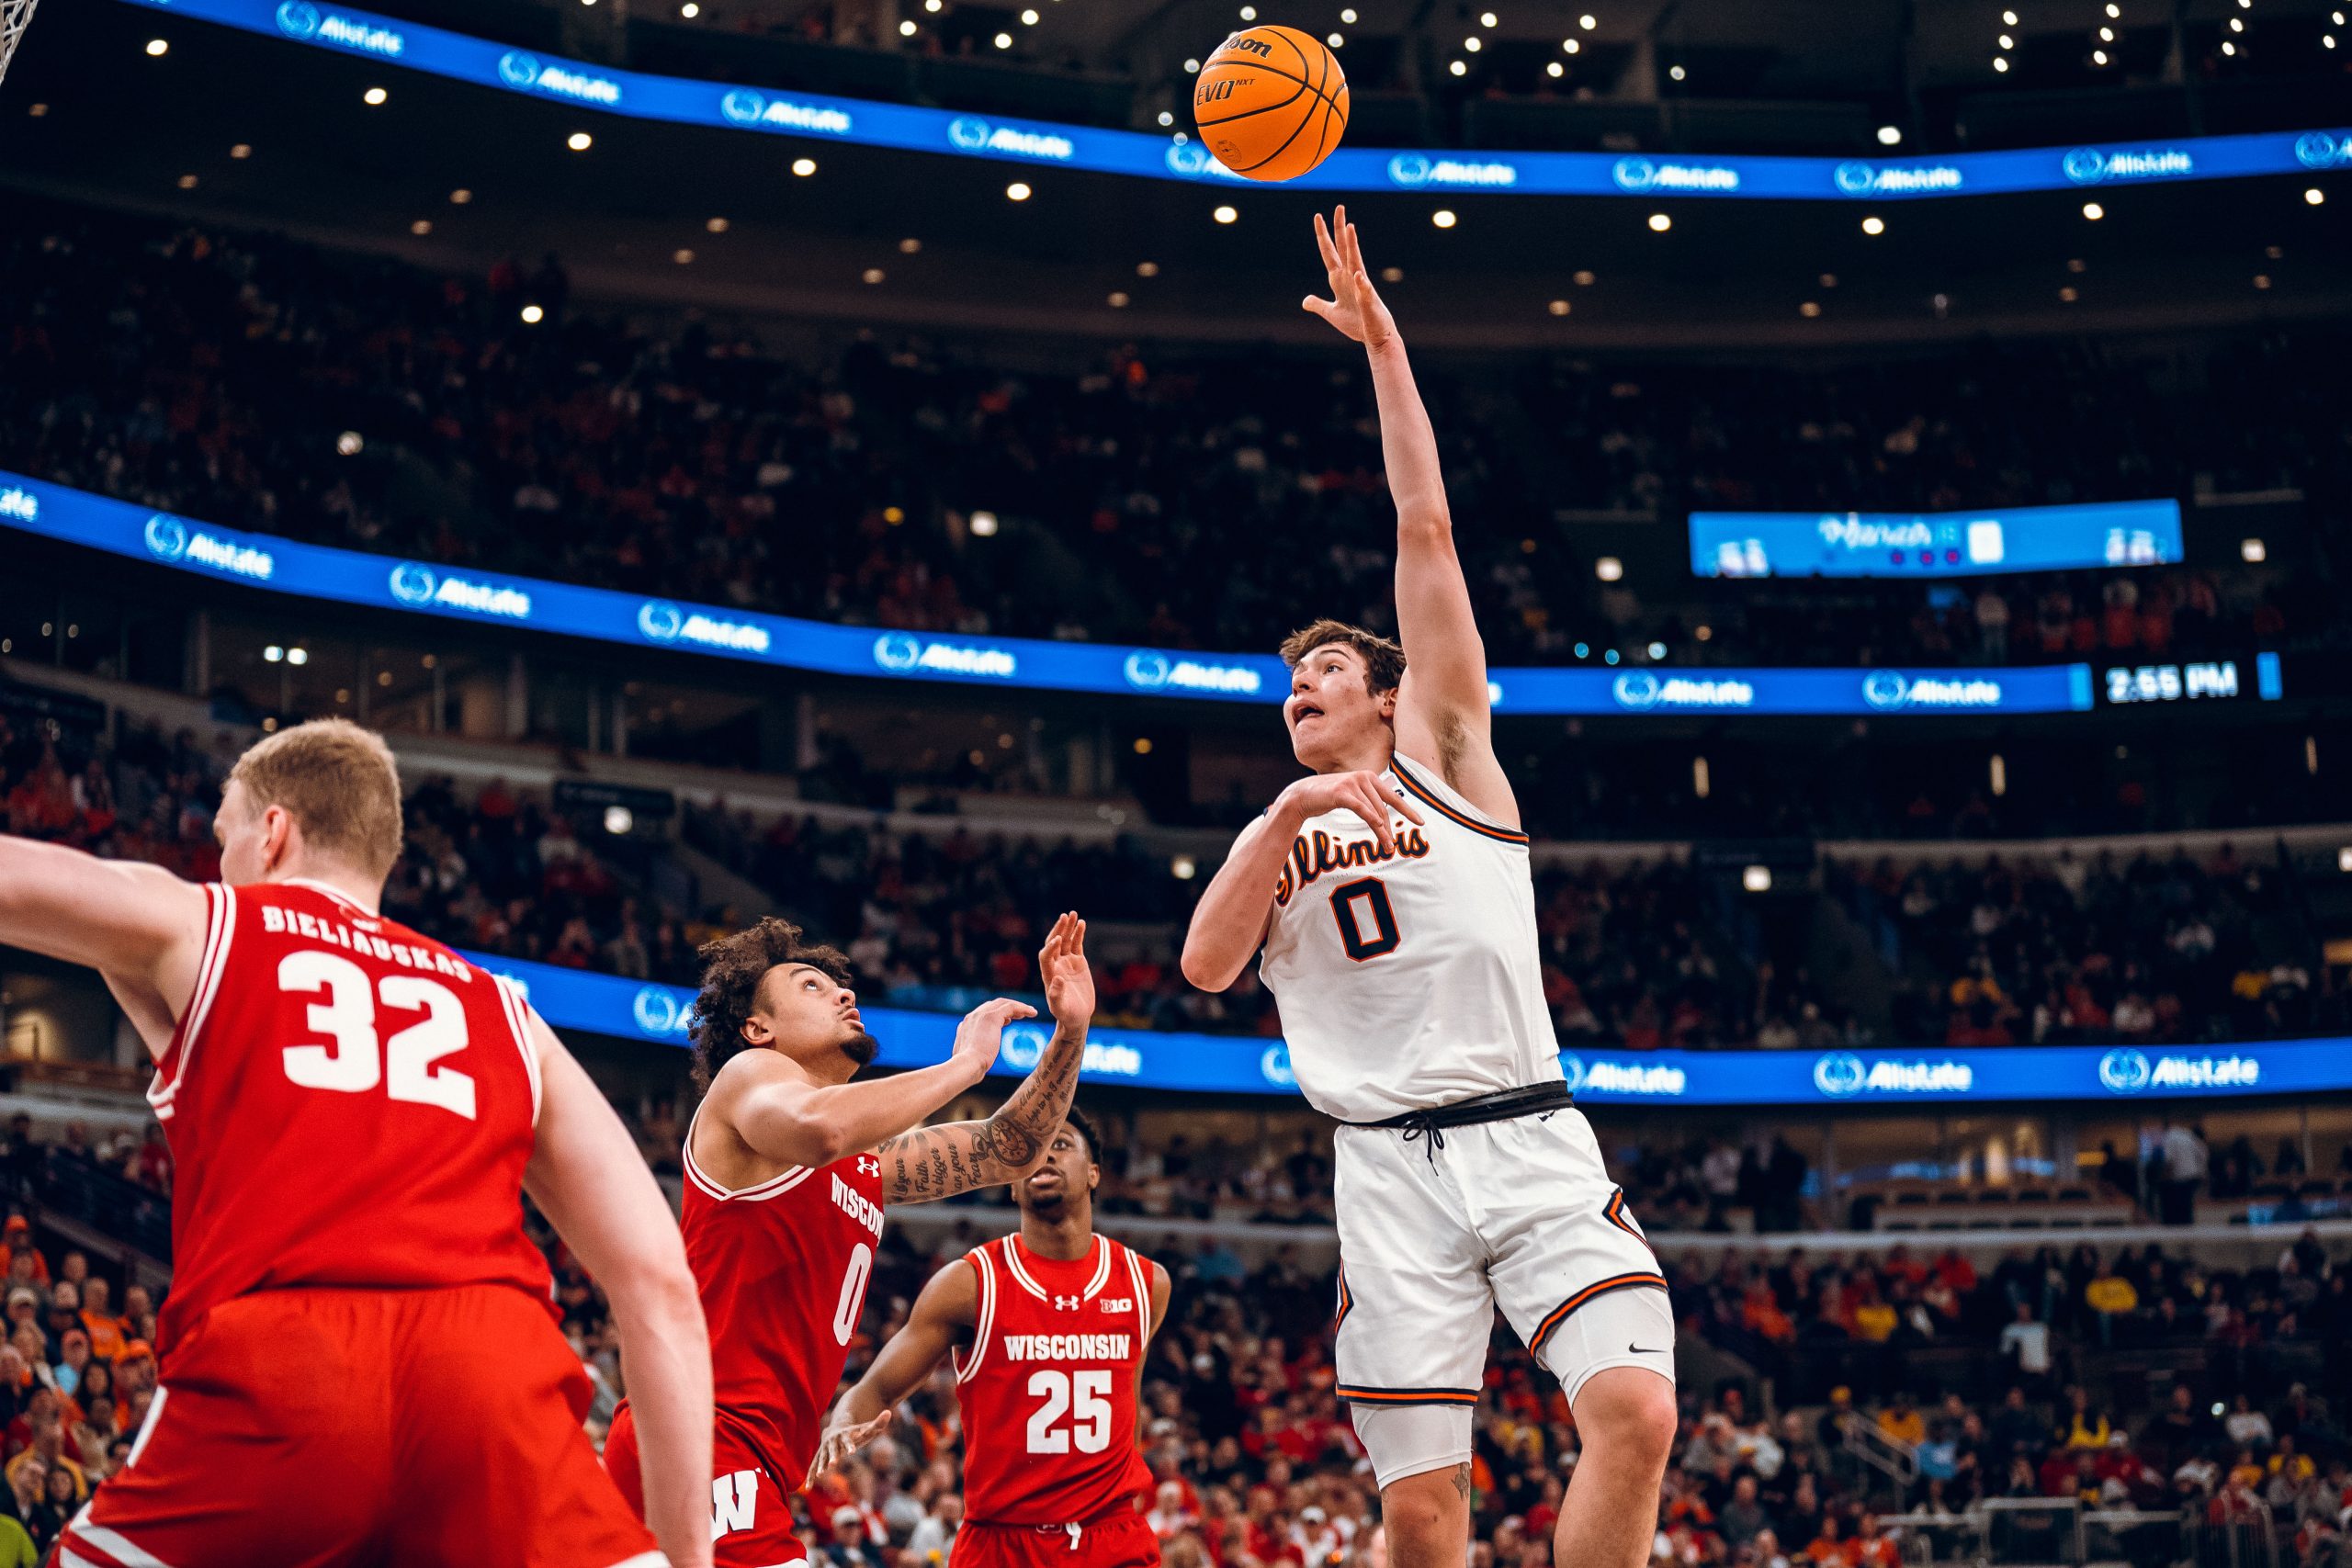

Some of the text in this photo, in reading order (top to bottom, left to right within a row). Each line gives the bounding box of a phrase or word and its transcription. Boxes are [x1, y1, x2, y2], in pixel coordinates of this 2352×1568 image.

[1236, 78, 1256, 86] NXT
[2106, 661, 2238, 704] 2:55 PM
[1329, 875, 1401, 963] 0
[262, 906, 472, 983] BIELIAUSKAS
[277, 950, 477, 1121] 32
[1586, 1062, 1686, 1096] Allstate
[1864, 1061, 1973, 1092] Allstate
[2151, 1056, 2259, 1087] Allstate
[914, 1159, 931, 1192] Faith
[931, 1146, 948, 1186] bigger
[833, 1242, 872, 1347] 0
[1004, 1335, 1131, 1360] WISCONSIN
[1026, 1370, 1112, 1454] 25
